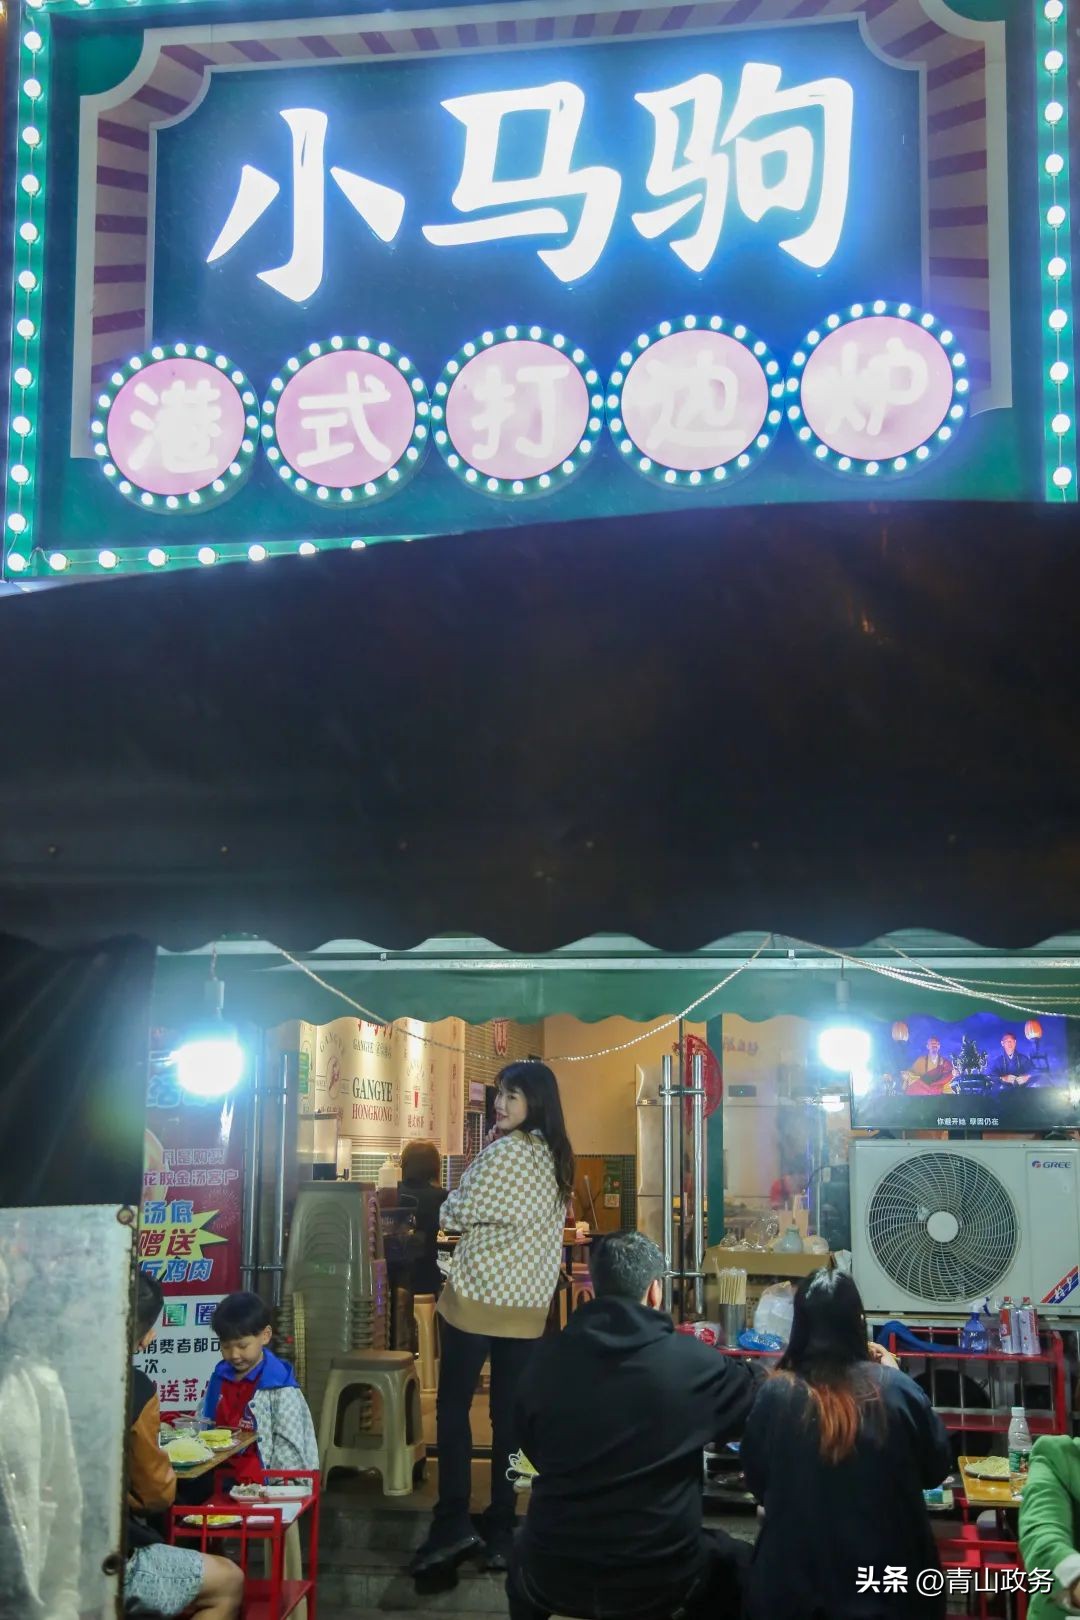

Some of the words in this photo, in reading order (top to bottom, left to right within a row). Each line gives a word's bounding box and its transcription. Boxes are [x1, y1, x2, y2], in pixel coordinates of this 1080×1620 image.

[207, 62, 855, 302] 小马驹
[130, 336, 929, 478] 港式打边炉
[352, 1076, 393, 1102] GANGYE
[352, 1103, 393, 1121] HONGKONG
[1043, 1161, 1072, 1169] GREE
[144, 1199, 194, 1225] 汤底
[139, 1228, 199, 1257] 赠送
[133, 1337, 221, 1355] 消费者都可
[152, 1378, 210, 1402] 送菜
